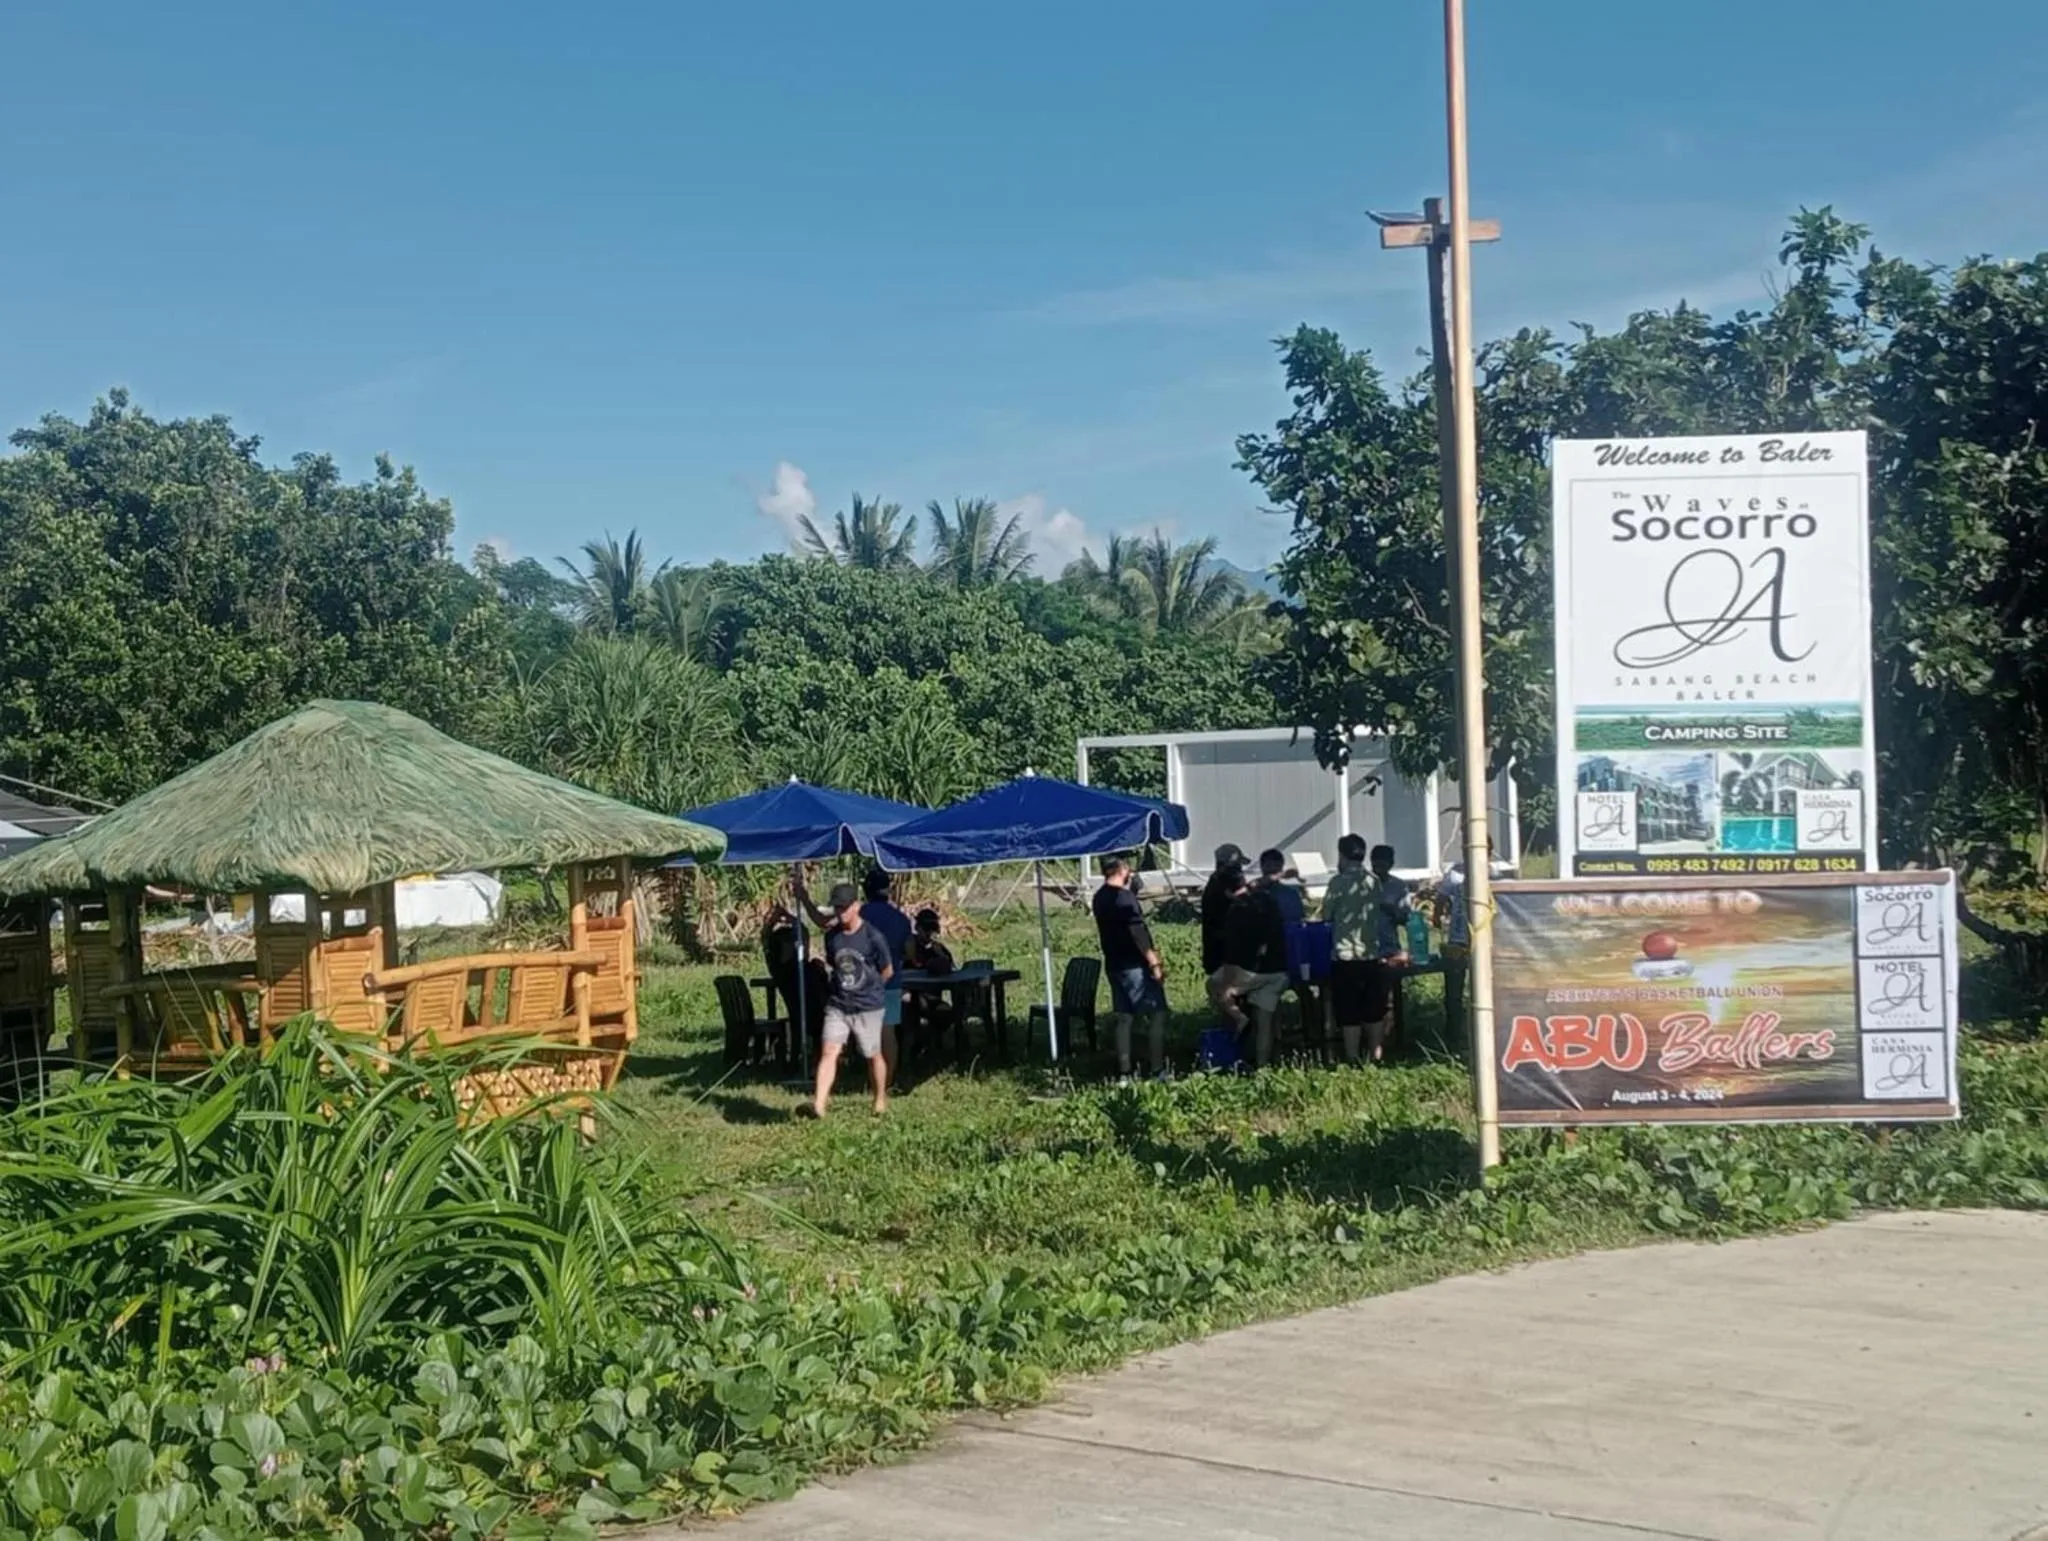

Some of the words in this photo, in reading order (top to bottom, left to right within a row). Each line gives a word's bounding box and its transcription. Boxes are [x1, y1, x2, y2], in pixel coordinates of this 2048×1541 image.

[1593, 443, 1711, 466] Welcome
[1719, 446, 1745, 464] to
[1757, 438, 1834, 463] Baler
[1611, 491, 1632, 500] The
[1641, 493, 1789, 513] Waves
[1611, 508, 1818, 542] Socorro
[1614, 675, 1713, 687] SABANG
[1735, 673, 1817, 685] BEACH
[1676, 690, 1755, 701] BALER
[1711, 858, 1746, 871] 7492
[1864, 889, 1934, 903] Socorro
[1874, 961, 1928, 973] HOTEL
[1502, 1013, 1647, 1072] ABU
[1658, 1010, 1836, 1072] Ballers
[1612, 1089, 1658, 1104] August
